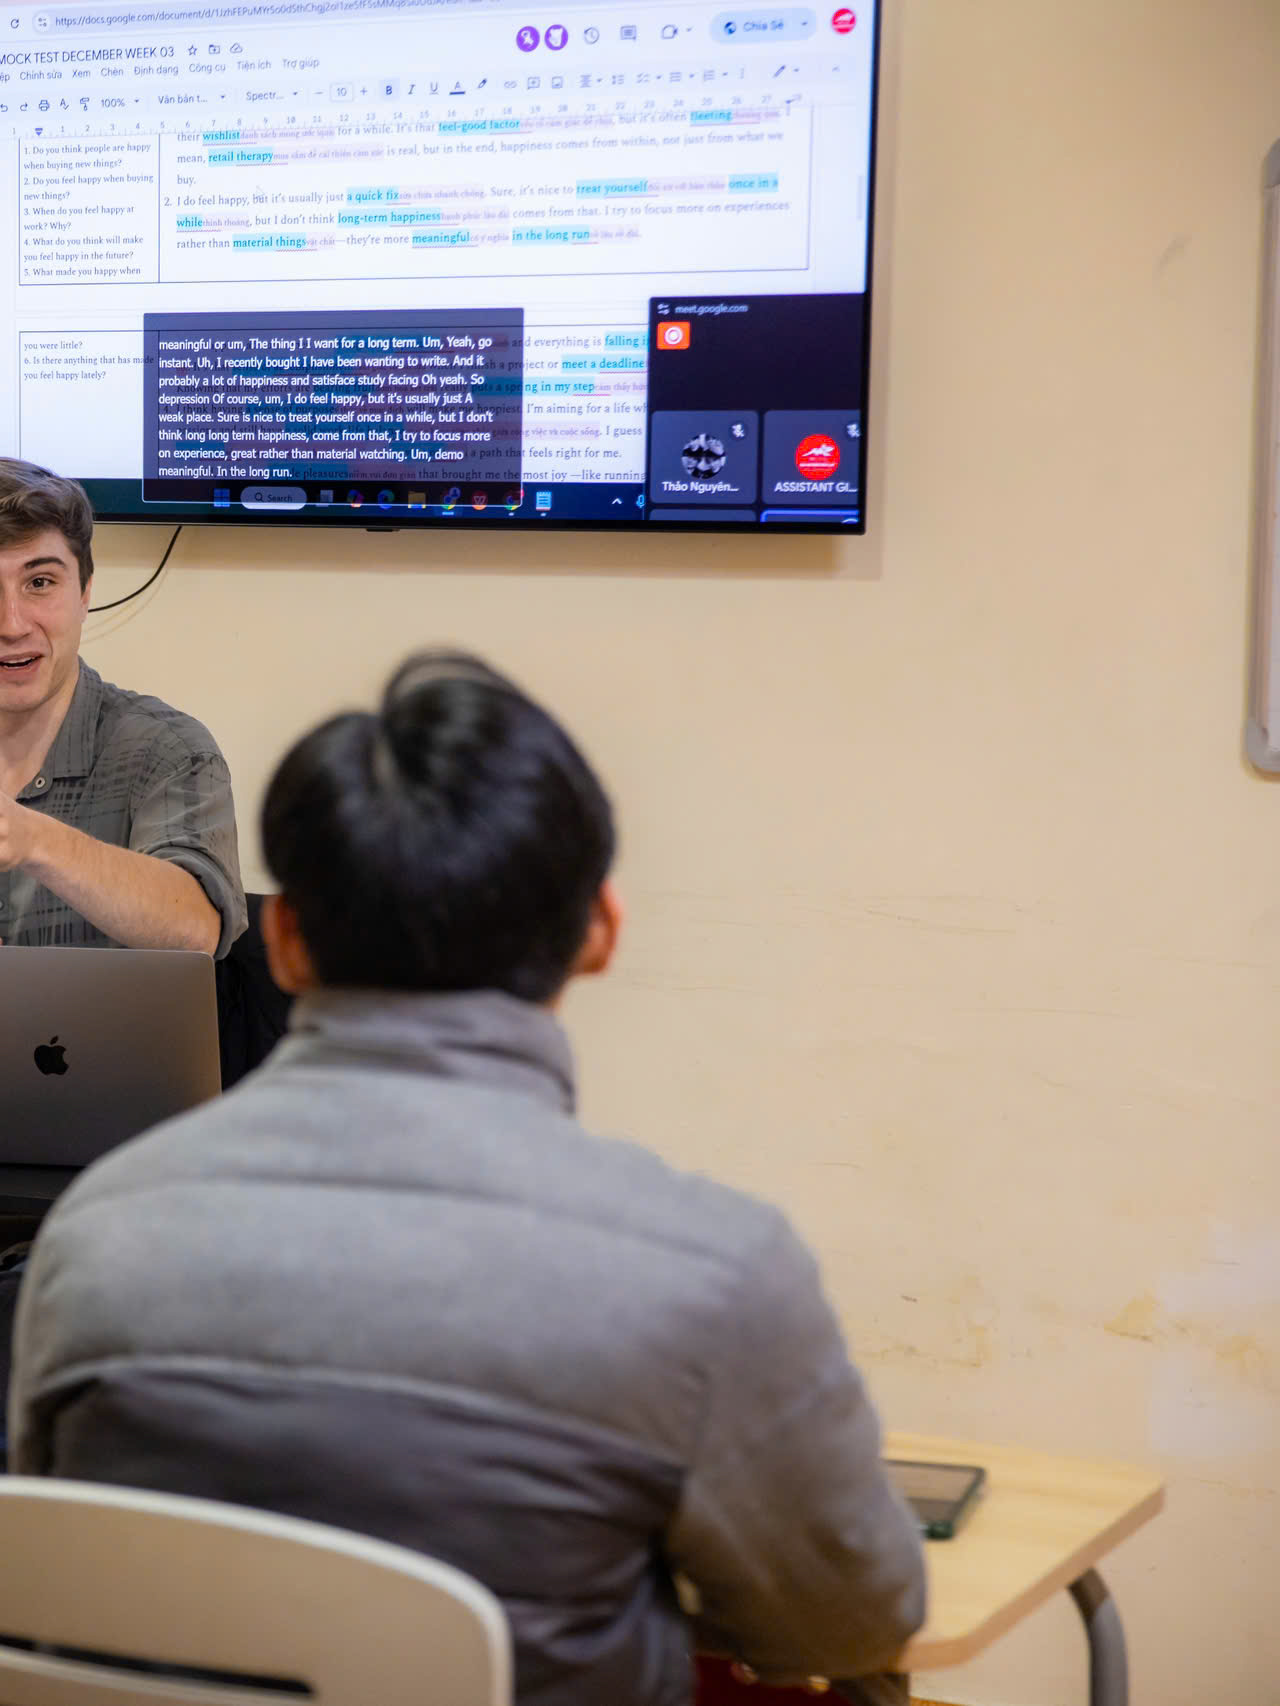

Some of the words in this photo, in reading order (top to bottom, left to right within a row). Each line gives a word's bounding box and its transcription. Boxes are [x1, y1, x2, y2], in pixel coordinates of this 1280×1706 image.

[34, 52, 60, 63] TEST
[62, 49, 122, 62] DECEMBER
[124, 48, 158, 59] WEEK
[160, 47, 174, 58] 03
[72, 67, 90, 77] Xem
[336, 87, 348, 97] 10
[100, 98, 125, 109] 100%
[24, 145, 30, 154] 1.
[32, 145, 44, 154] Do
[46, 147, 60, 156] you
[62, 143, 82, 153] think
[84, 142, 112, 154] people
[126, 141, 152, 153] happy
[24, 159, 44, 169] when
[46, 159, 74, 171] buying
[92, 157, 122, 170] things?
[177, 175, 196, 188] buy.
[164, 195, 172, 206] 2.
[176, 194, 182, 206] I
[184, 194, 196, 205] do
[198, 193, 216, 205] feel
[218, 192, 250, 207] happy,
[252, 191, 268, 203] but
[288, 189, 324, 205] usually
[326, 189, 344, 203] just
[354, 187, 384, 202] quick
[24, 221, 48, 230] work?
[50, 220, 72, 232] Why?
[675, 304, 748, 315] meet.google.com
[24, 343, 38, 352] you
[60, 339, 84, 349] little?
[158, 338, 212, 352] meaningful
[214, 341, 226, 349] or
[228, 340, 246, 350] um,
[248, 337, 268, 348] The
[270, 337, 296, 351] thing
[298, 337, 304, 348] I
[306, 337, 312, 348] I
[314, 338, 338, 348] want
[340, 337, 356, 348] for
[358, 340, 364, 348] a
[368, 337, 390, 350] long
[392, 338, 420, 347] term.
[422, 336, 444, 349] Um,
[446, 336, 476, 349] Yeah,
[478, 339, 492, 350] go
[158, 356, 194, 368] instant.
[196, 356, 214, 369] Uh,
[216, 356, 222, 367] I
[224, 356, 262, 370] recently
[266, 356, 300, 370] bought
[302, 356, 308, 367] I
[310, 356, 334, 367] have
[338, 355, 362, 366] been
[364, 355, 404, 369] wanting
[406, 357, 418, 366] to
[420, 355, 450, 366] write.
[452, 355, 474, 366] And
[476, 355, 484, 366] it
[158, 374, 200, 388] probably
[202, 377, 208, 385] a
[212, 374, 224, 385] lot
[226, 374, 238, 385] of
[240, 374, 288, 388] happiness
[290, 374, 310, 385] and
[312, 374, 356, 385] satisface
[358, 374, 386, 387] study
[388, 373, 418, 387] facing
[422, 373, 436, 384] Oh
[440, 373, 468, 387] yeah.
[470, 373, 484, 384] So
[158, 393, 210, 407] depression
[212, 393, 224, 404] Of
[226, 395, 262, 406] course,
[266, 395, 284, 405] um,
[288, 392, 292, 403] I
[294, 392, 306, 403] do
[310, 392, 328, 403] feel
[332, 392, 364, 406] happy,
[368, 392, 384, 403] but
[388, 392, 402, 403] it's
[406, 392, 440, 406] usually
[442, 392, 462, 406] just
[464, 392, 472, 403] A
[158, 411, 184, 422] weak
[186, 411, 214, 424] place.
[216, 411, 240, 421] Sure
[242, 411, 250, 421] is
[252, 410, 274, 421] nice
[276, 412, 286, 421] to
[288, 412, 312, 421] treat
[314, 410, 356, 424] yourself
[356, 413, 382, 421] once
[384, 410, 394, 421] in
[396, 413, 404, 421] a
[406, 410, 436, 423] while,
[438, 410, 456, 421] but
[458, 410, 464, 421] I
[466, 410, 494, 421] don't
[160, 429, 182, 440] think
[186, 429, 206, 443] long
[208, 429, 228, 443] long
[232, 430, 254, 440] term
[258, 429, 308, 442] happiness,
[312, 432, 338, 440] come
[342, 429, 364, 440] from
[368, 429, 392, 442] that,
[396, 429, 400, 440] I
[404, 430, 416, 442] try
[420, 430, 430, 440] to
[434, 429, 460, 440] focus
[464, 432, 490, 440] more
[158, 450, 170, 458] on
[174, 447, 228, 461] experience,
[230, 449, 256, 461] great
[260, 447, 288, 458] rather
[292, 447, 314, 458] than
[316, 447, 356, 458] material
[360, 448, 406, 461] watching.
[412, 448, 430, 461] Um,
[436, 448, 464, 459] demo
[530, 446, 552, 458] feels
[556, 446, 580, 461] right
[584, 446, 600, 458] for
[604, 450, 622, 458] me.
[158, 465, 214, 479] meaningful.
[218, 465, 228, 476] In
[230, 465, 246, 476] the
[250, 465, 270, 479] long
[272, 468, 292, 476] run.
[774, 483, 835, 493] ASSISTANT
